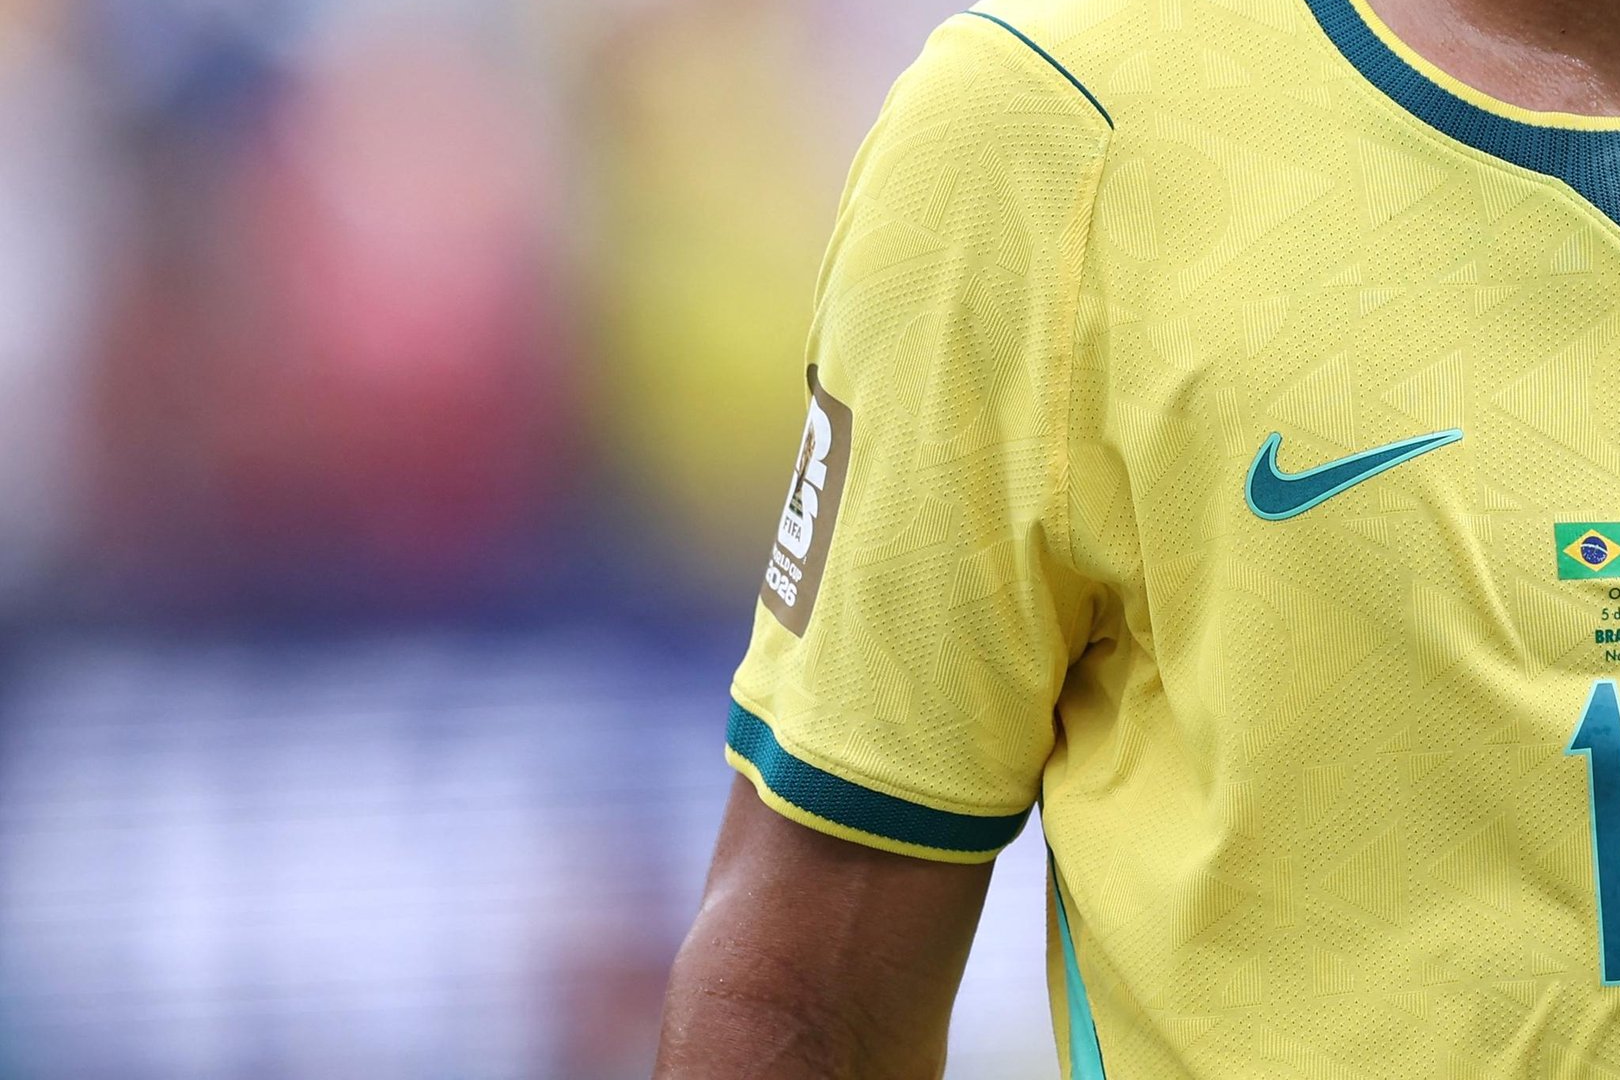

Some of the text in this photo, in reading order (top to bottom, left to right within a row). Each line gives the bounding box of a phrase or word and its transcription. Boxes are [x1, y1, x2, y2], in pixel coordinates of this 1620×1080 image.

[783, 516, 802, 542] FIFA
[789, 563, 803, 583] CUP
[1601, 608, 1609, 621] 5
